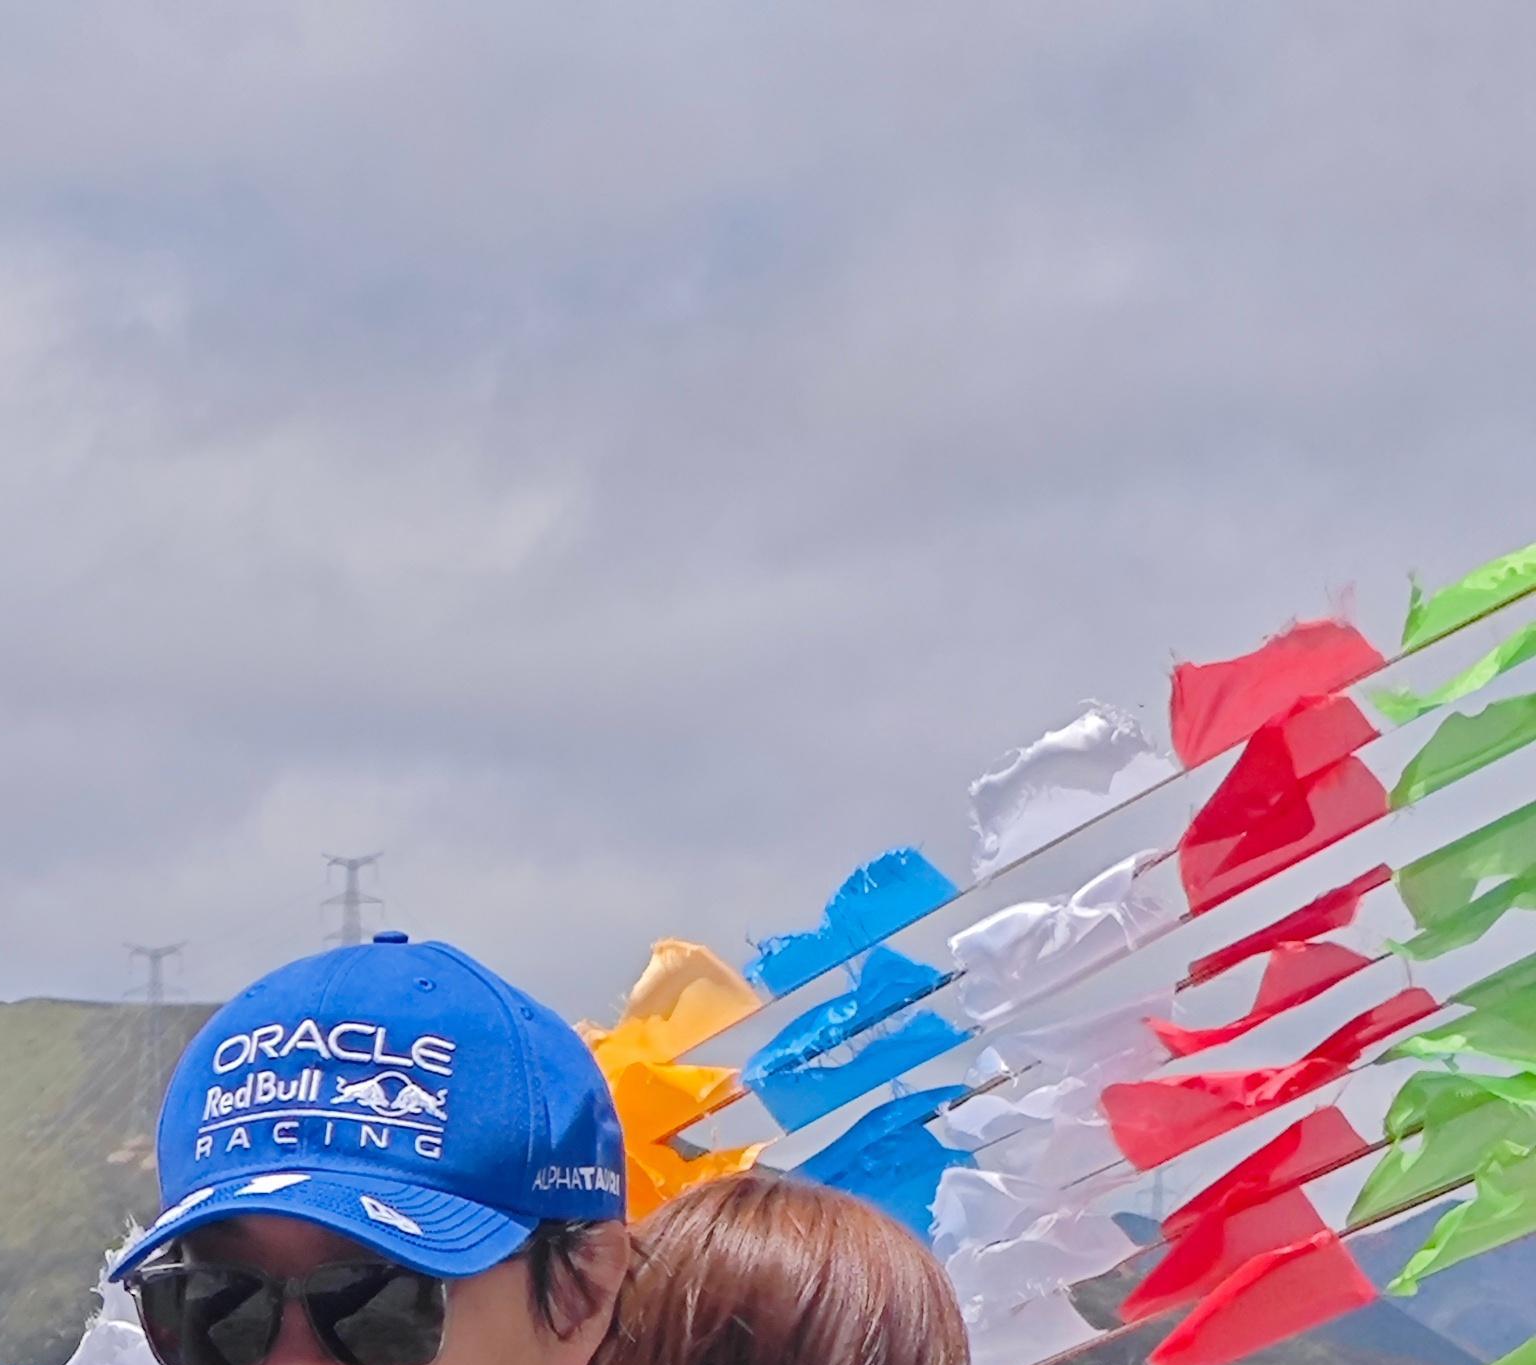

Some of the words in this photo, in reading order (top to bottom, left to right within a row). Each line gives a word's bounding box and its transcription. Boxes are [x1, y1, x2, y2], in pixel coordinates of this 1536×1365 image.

[212, 1018, 456, 1077] ORACLE
[194, 1120, 444, 1162] RACING
[531, 1165, 621, 1197] ALPHATAURI
